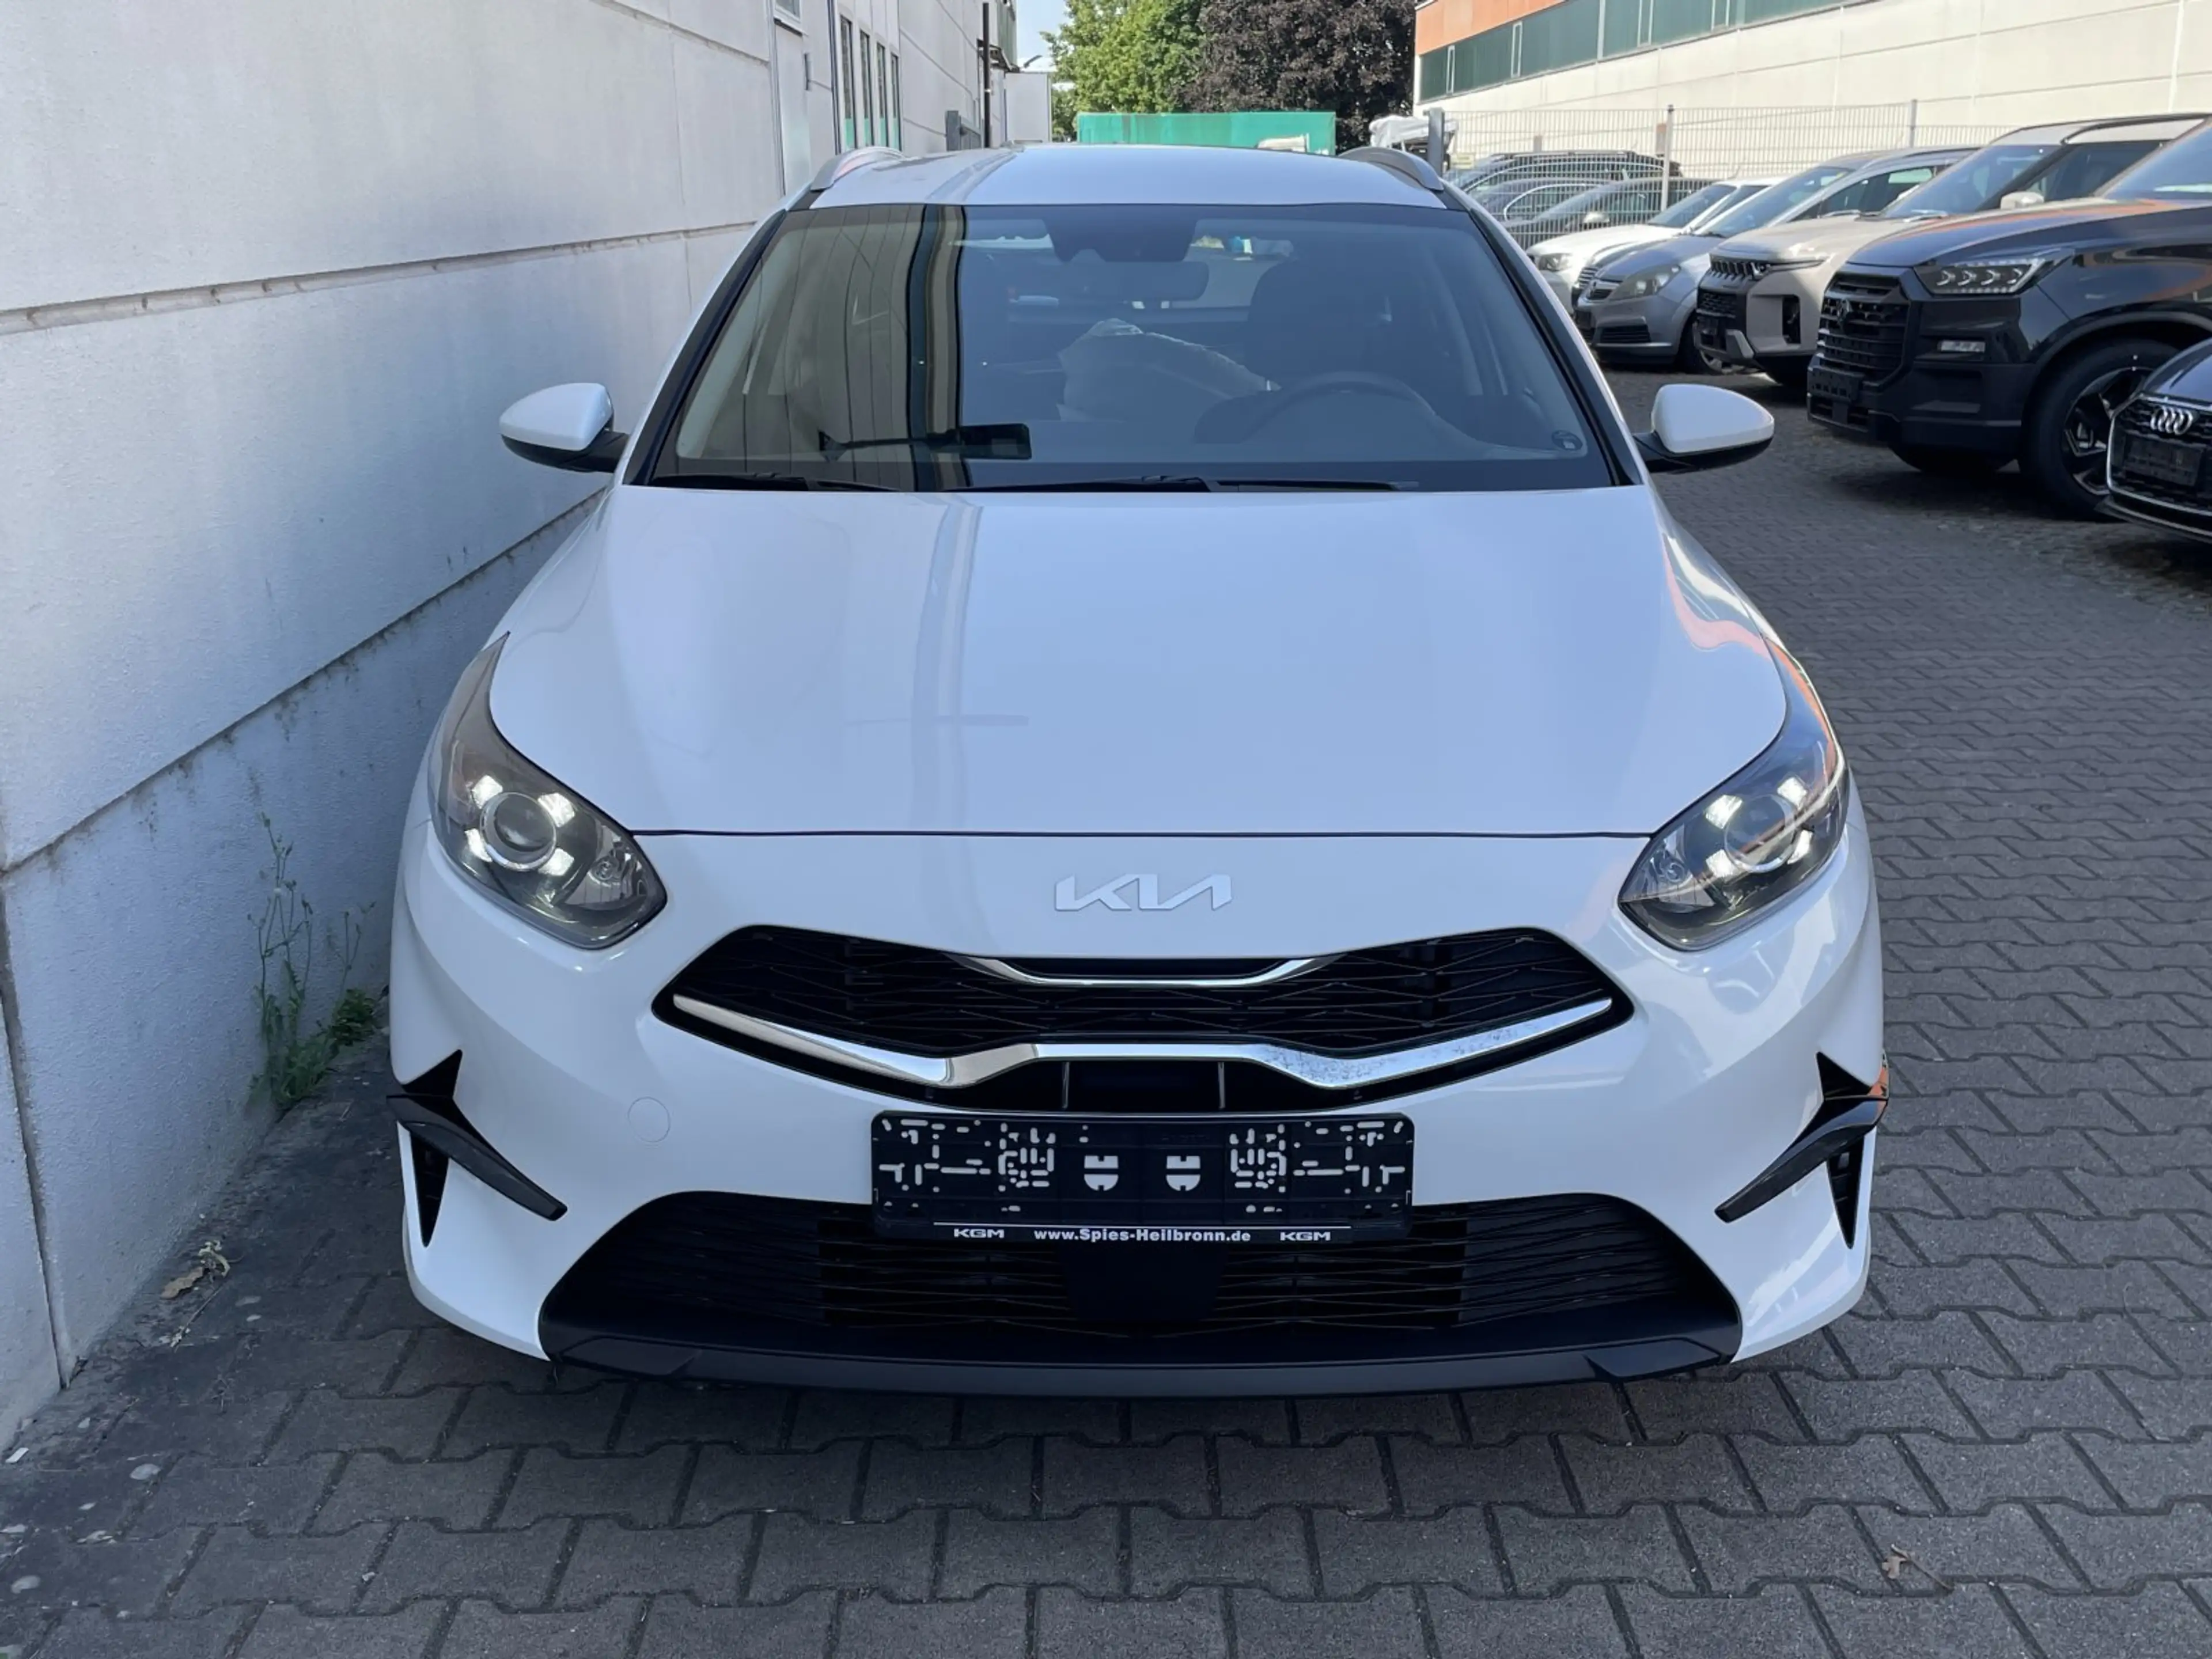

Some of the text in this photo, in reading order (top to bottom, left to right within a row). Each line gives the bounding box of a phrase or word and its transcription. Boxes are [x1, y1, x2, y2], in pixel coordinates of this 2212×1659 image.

[1055, 874, 1232, 911] KIA
[953, 1228, 1331, 1242] KGM www.Spies-Heilbronn.de KGM
